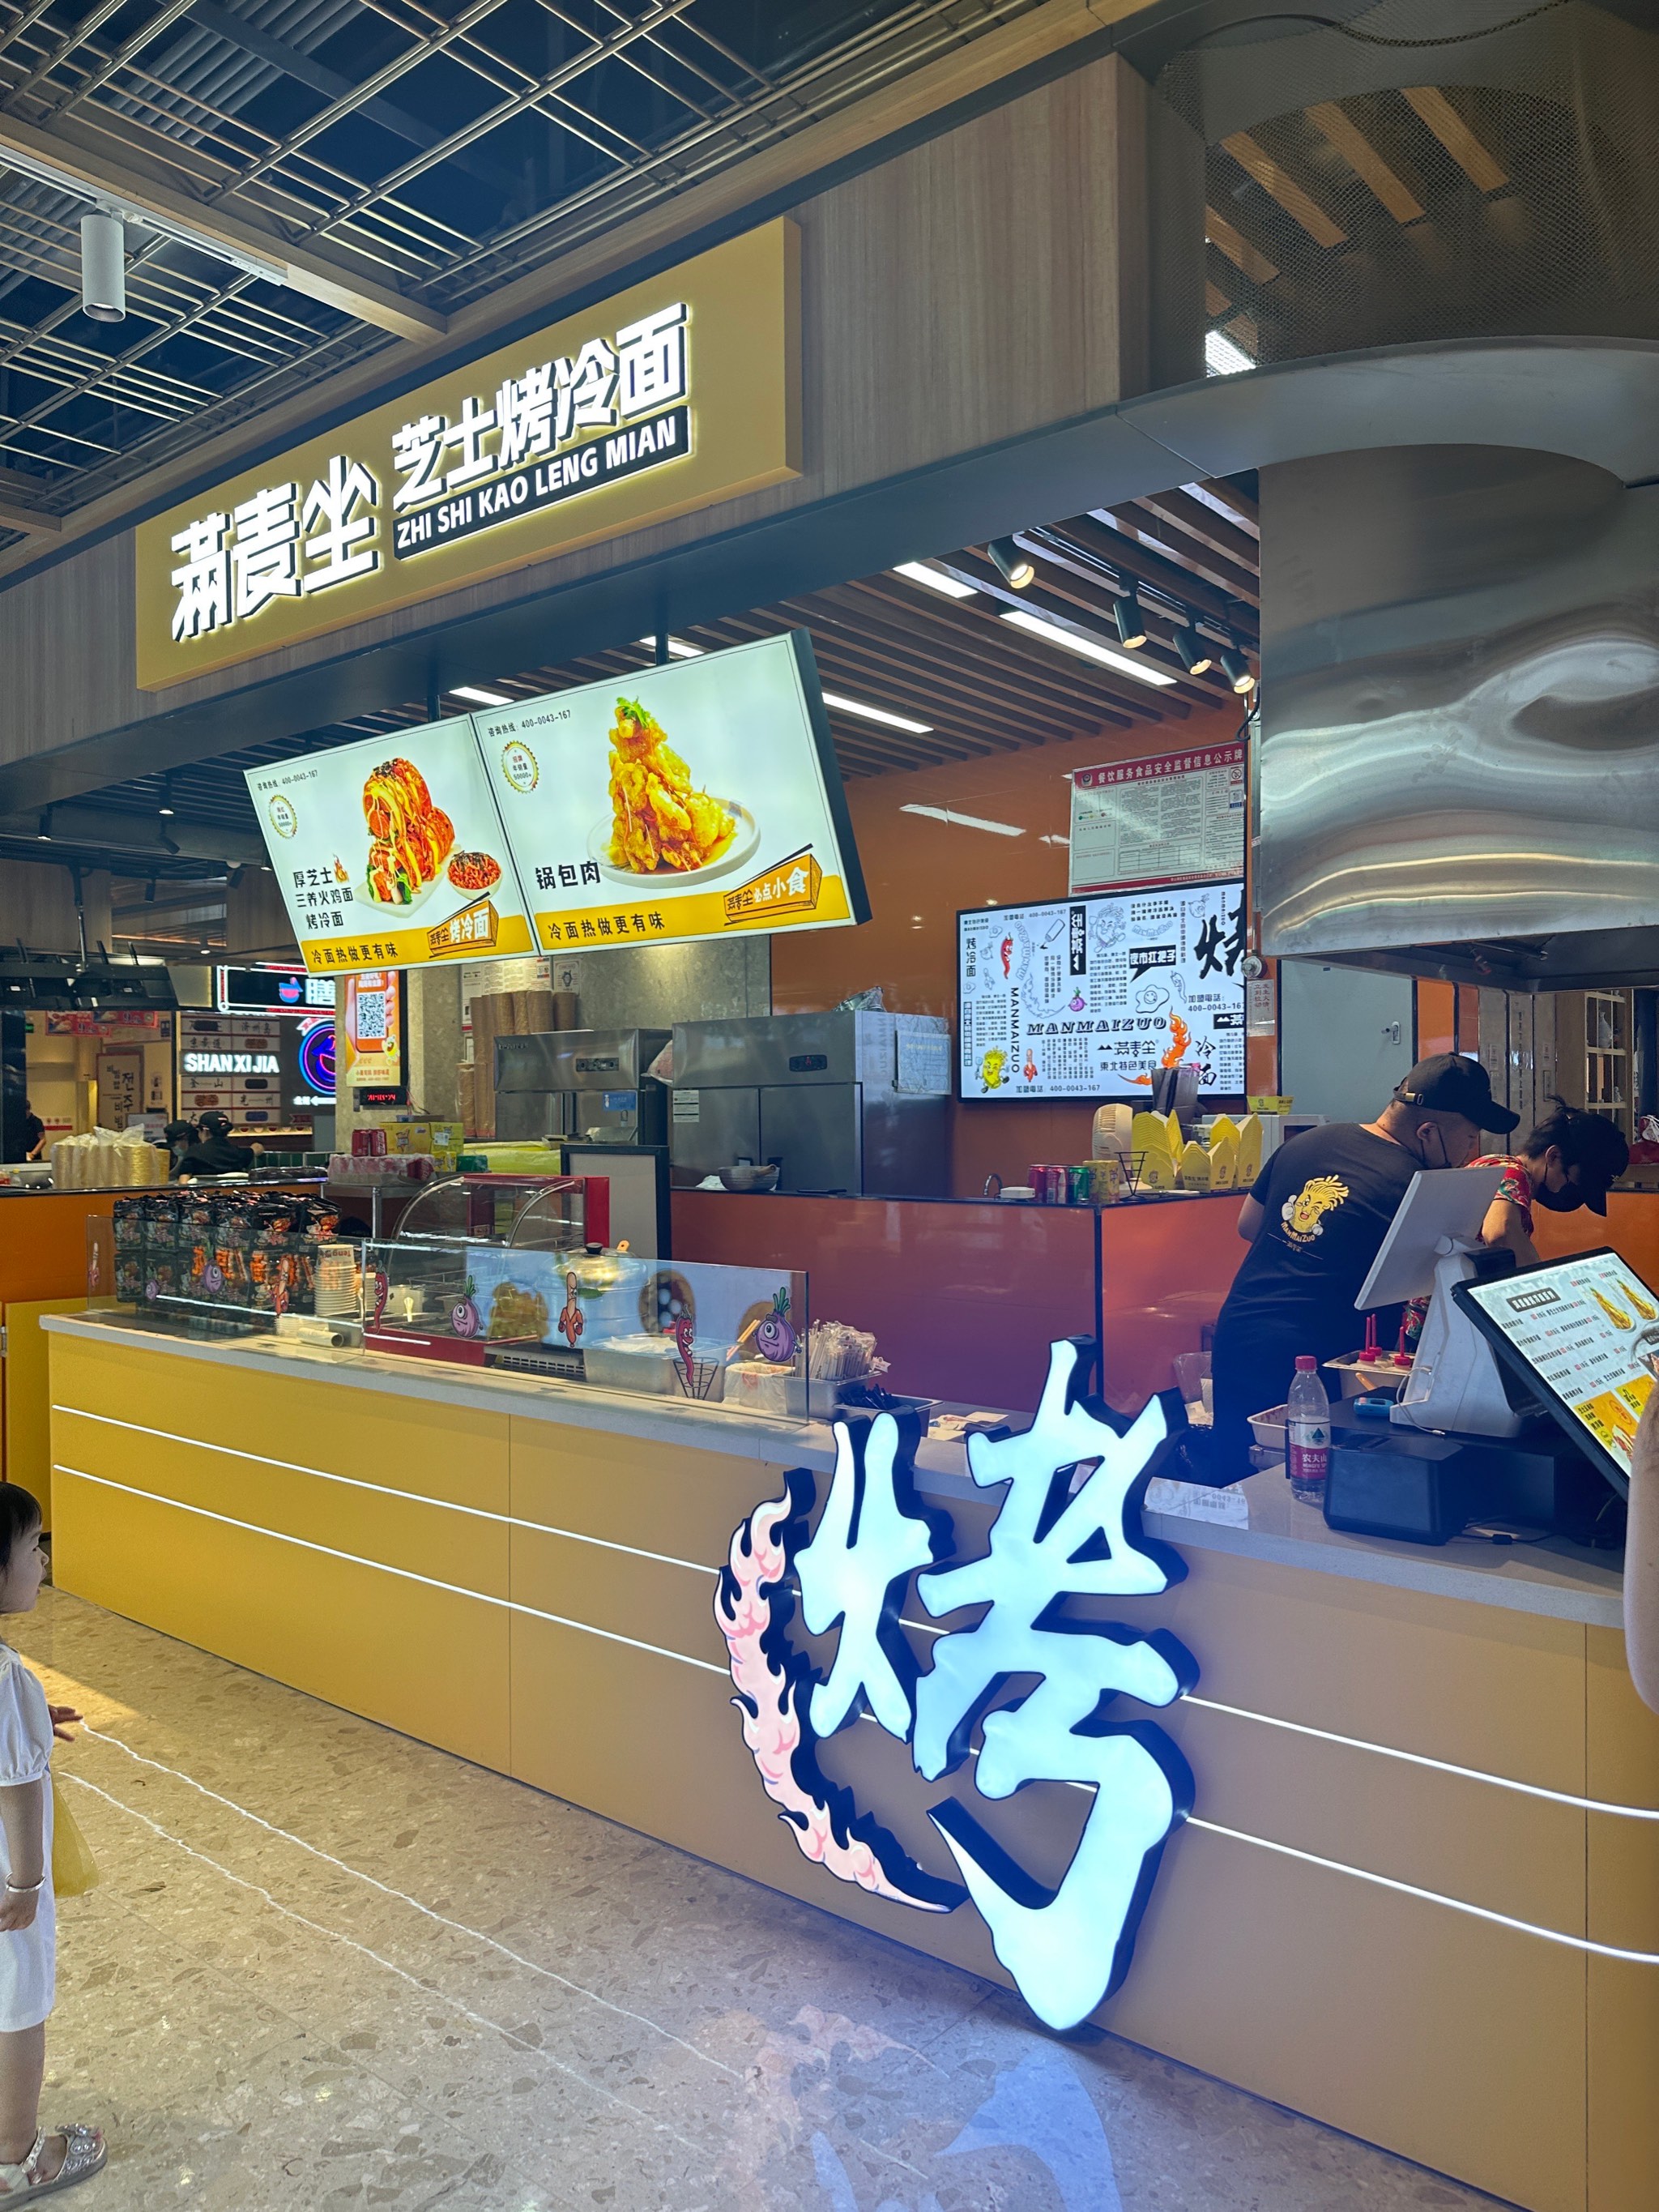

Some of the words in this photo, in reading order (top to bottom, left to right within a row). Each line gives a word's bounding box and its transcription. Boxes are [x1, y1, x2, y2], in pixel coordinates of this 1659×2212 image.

[392, 302, 689, 513] 芝士烤冷面
[397, 514, 433, 549] ZHI
[437, 497, 471, 534] SHI
[479, 479, 528, 515] KAO
[535, 453, 599, 497] LENG
[606, 415, 676, 469] MIAN
[522, 710, 571, 729] 400-0043-167
[282, 770, 318, 785] 400-0043-167
[1098, 749, 1243, 784] 餐饮服务食品安全监督信息公示牌
[292, 867, 333, 888] 厚芝士
[535, 860, 599, 890] 锅包肉
[753, 866, 809, 903] 必点小食
[295, 887, 354, 907] 三养火鸡面
[305, 911, 343, 929] 烤冷面
[450, 907, 489, 943] 烤冷面
[1029, 909, 1067, 918] 400-0043-167
[548, 912, 665, 940] 冷面热做更有味
[311, 942, 399, 965] 冷面热做更有味
[966, 937, 976, 977] 烤冷面
[1011, 988, 1020, 1073] MANMAIZUO
[1026, 1016, 1166, 1036] MANMAIZUO
[252, 1055, 280, 1074] JIA
[1100, 1060, 1157, 1071] 東北特色美食
[1050, 1084, 1100, 1092] 400-0043-167
[794, 1337, 1199, 2031] 烤
